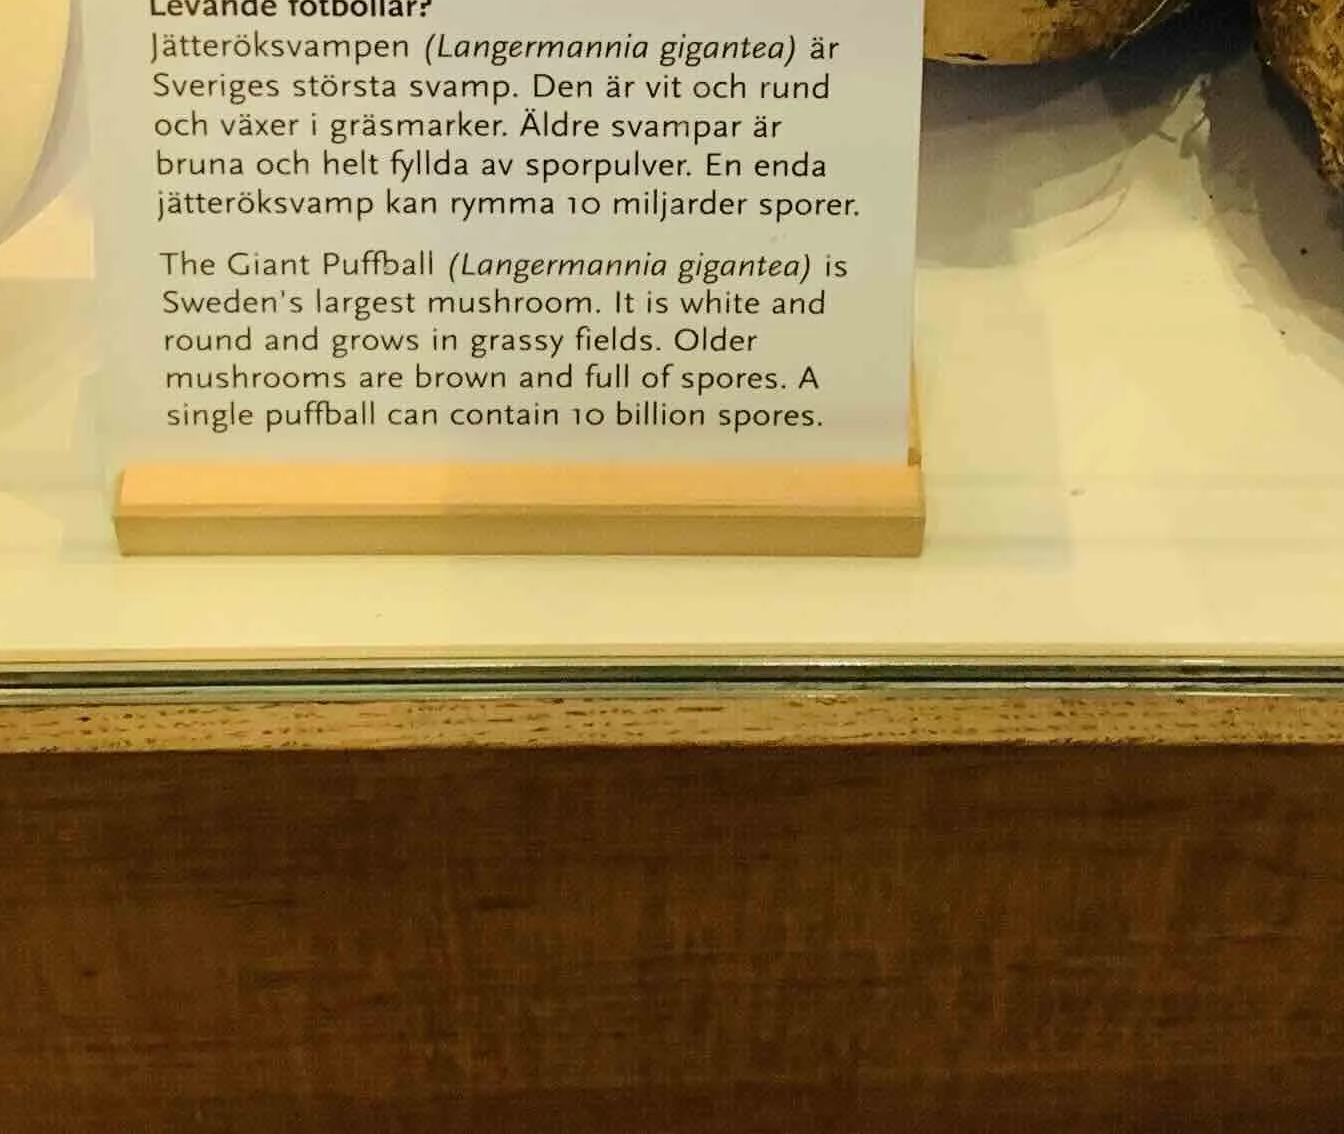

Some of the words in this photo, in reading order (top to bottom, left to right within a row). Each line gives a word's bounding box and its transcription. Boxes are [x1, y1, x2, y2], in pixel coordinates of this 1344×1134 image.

[150, 29, 409, 67] Jätteröksvampen
[424, 32, 649, 67] (Langermannia
[659, 33, 796, 68] gigantea)
[809, 35, 840, 61] är
[152, 71, 280, 106] Sveriges
[292, 73, 397, 98] största
[409, 79, 519, 107] svamp.
[533, 73, 593, 99] Den
[605, 74, 636, 99] är
[644, 73, 683, 99] vit
[692, 71, 747, 99] och
[760, 72, 830, 100] rund
[154, 109, 208, 137] och
[219, 113, 300, 137] växer
[311, 112, 317, 137] i
[330, 109, 509, 145] gräsmarker.
[519, 107, 600, 138] Äldre
[611, 119, 743, 147] svampar
[752, 114, 783, 139] är
[156, 148, 245, 176] bruna
[255, 148, 310, 177] och
[323, 148, 380, 176] helt
[389, 147, 470, 184] fyllda
[481, 157, 515, 177] av
[525, 149, 692, 185] sporpulver.
[705, 152, 742, 178] En
[753, 150, 827, 179] enda
[157, 187, 375, 223] jätteröksvamp
[386, 187, 437, 215] kan
[450, 196, 555, 223] rymma
[567, 196, 601, 216] 10
[613, 187, 749, 223] miljarder
[759, 197, 860, 224] sporer.
[159, 249, 216, 277] The
[227, 251, 311, 277] Giant
[323, 249, 433, 277] Puffball
[448, 251, 668, 285] (Langermannia
[677, 251, 811, 286] gigantea)
[825, 253, 848, 279] is
[162, 287, 304, 315] Sweden's
[316, 287, 416, 322] largest
[428, 287, 601, 315] mushroom.
[615, 289, 635, 315] It
[647, 289, 669, 315] is
[679, 288, 761, 315] white
[771, 289, 826, 315] and
[164, 325, 253, 352] round
[264, 325, 319, 352] and
[331, 333, 420, 359] grows
[431, 327, 458, 352] in
[471, 333, 565, 359] grassy
[575, 324, 662, 352] fields.
[673, 325, 759, 353] Older
[166, 362, 347, 390] mushrooms
[359, 369, 404, 389] are
[415, 362, 507, 389] brown
[519, 361, 573, 389] and
[584, 362, 630, 389] full
[641, 362, 675, 389] of
[680, 371, 787, 397] spores.
[797, 365, 820, 390] A
[167, 400, 254, 434] single
[266, 399, 375, 434] puffball
[387, 408, 438, 427] can
[449, 401, 559, 426] contain
[571, 407, 605, 427] 10
[616, 399, 705, 427] billion
[717, 409, 823, 435] spores.
